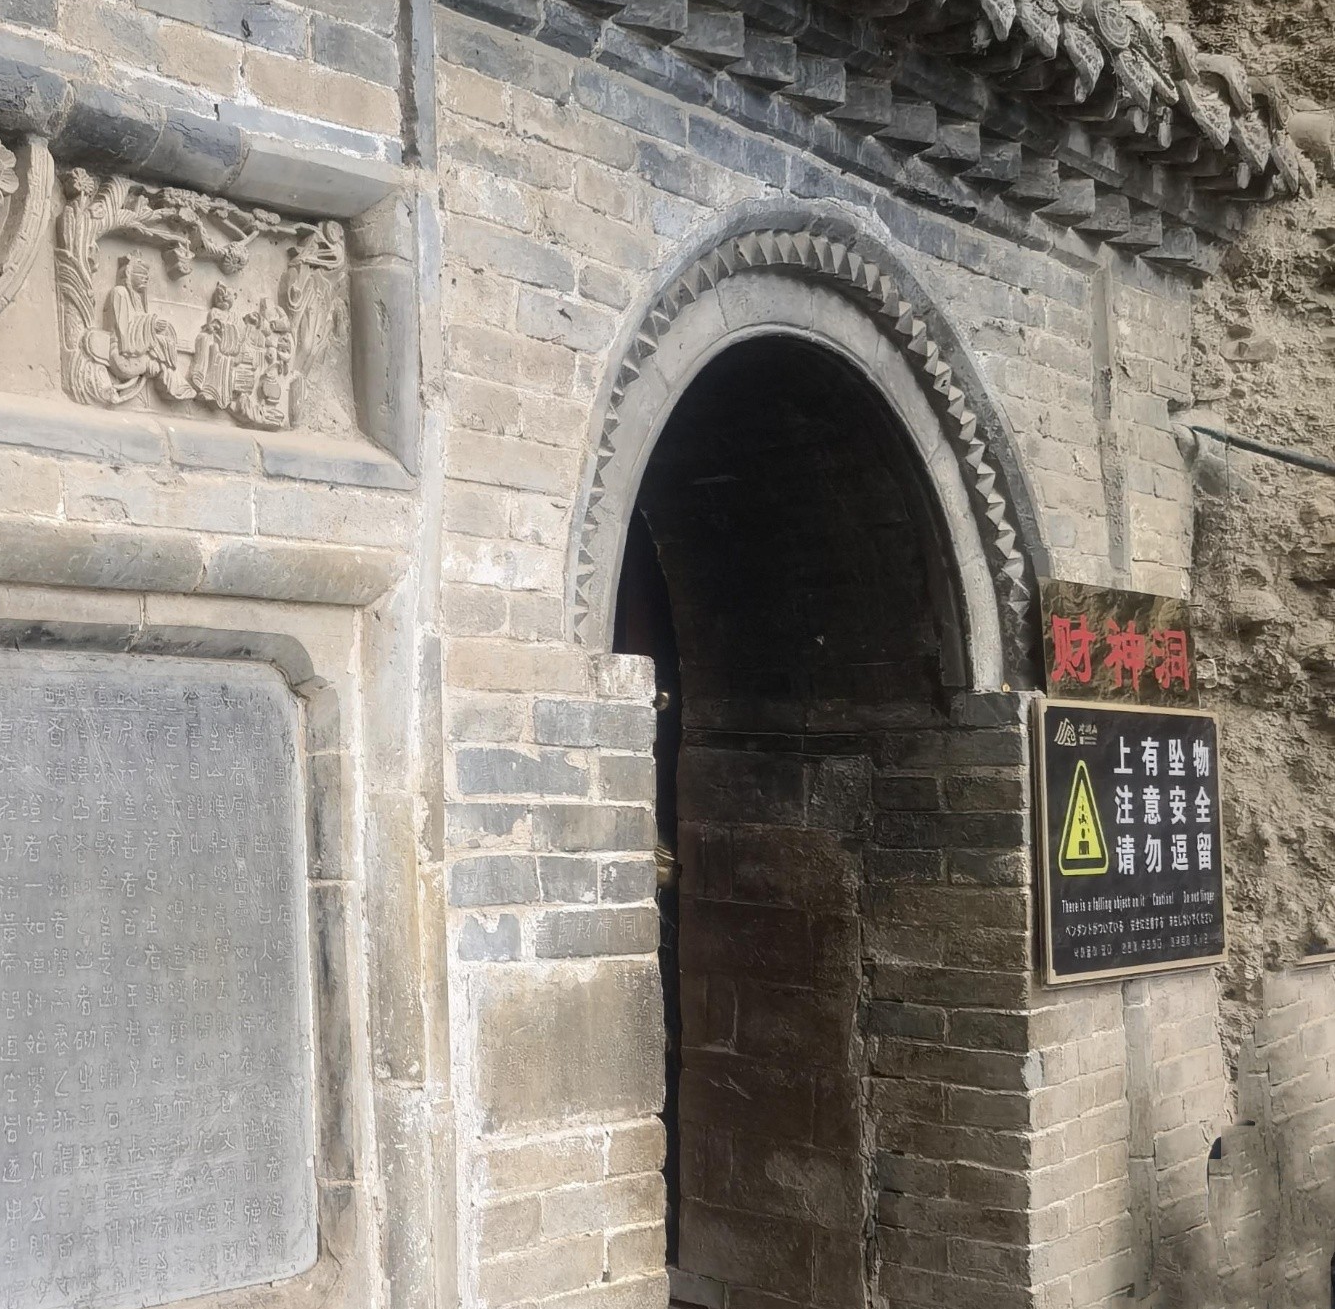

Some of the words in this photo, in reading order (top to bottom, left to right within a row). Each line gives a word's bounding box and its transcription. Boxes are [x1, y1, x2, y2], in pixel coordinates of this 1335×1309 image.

[1051, 613, 1189, 691] 财神洞
[1114, 736, 1210, 777] 上有坠物
[1114, 785, 1211, 824] 注意安全
[1115, 832, 1212, 875] 请勿逗留
